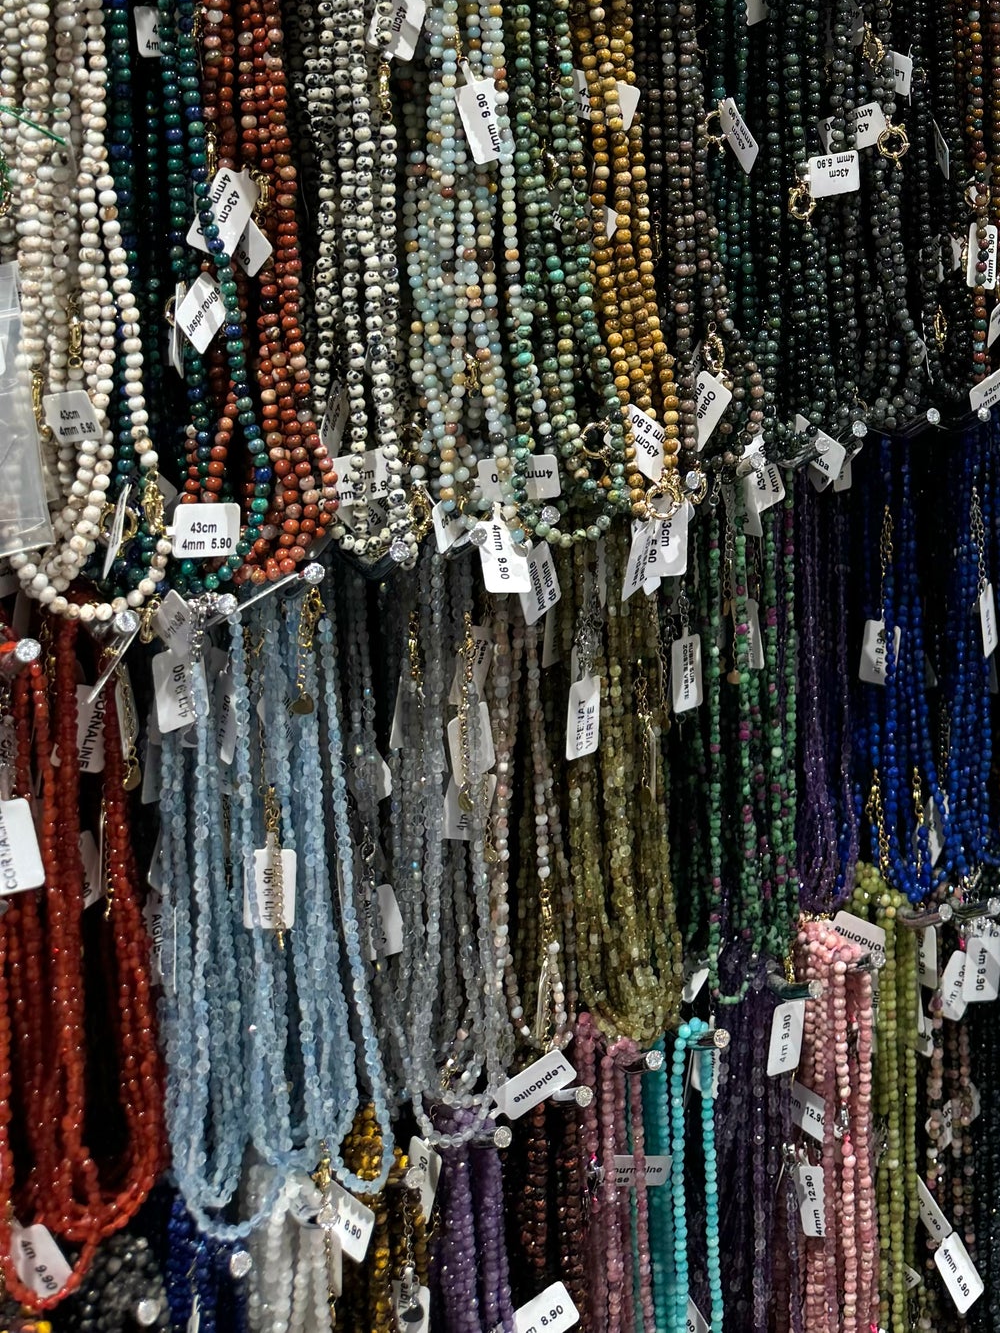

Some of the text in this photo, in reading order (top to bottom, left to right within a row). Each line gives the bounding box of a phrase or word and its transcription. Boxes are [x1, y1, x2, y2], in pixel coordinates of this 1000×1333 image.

[391, 6, 407, 34] 43cm
[476, 93, 501, 153] 9.90 4mm
[731, 124, 746, 150] 43cm
[738, 126, 754, 149] 4mm
[816, 154, 856, 168] 5.90 4mm
[828, 168, 850, 178] 43cm
[212, 173, 232, 206] 4mm
[219, 189, 241, 225] 43cm
[986, 232, 996, 284] 4mm 8.90
[187, 286, 221, 337] Jaspe rouge
[60, 409, 80, 420] 43cm
[697, 390, 717, 420] Opale
[60, 422, 96, 437] 4mm 5.90
[632, 414, 653, 435] 5.90
[634, 433, 660, 459] 43cm
[765, 469, 780, 494] 4mm
[190, 521, 218, 533] 43cm
[182, 537, 232, 551] 4mm 5.90
[493, 523, 511, 581] 4mm 9.90
[530, 561, 545, 612] Amazonite
[548, 591, 558, 601] de
[976, 968, 986, 991] 9.90
[781, 1014, 791, 1040] 9.90
[513, 1065, 567, 1103] Lepidolite
[804, 1174, 823, 1236] 4mm 12.90
[343, 1219, 363, 1240] 8.90
[34, 1265, 57, 1291] 9.90
[943, 1249, 969, 1297] 4mm 8.90
[541, 1305, 563, 1326] 8.90
